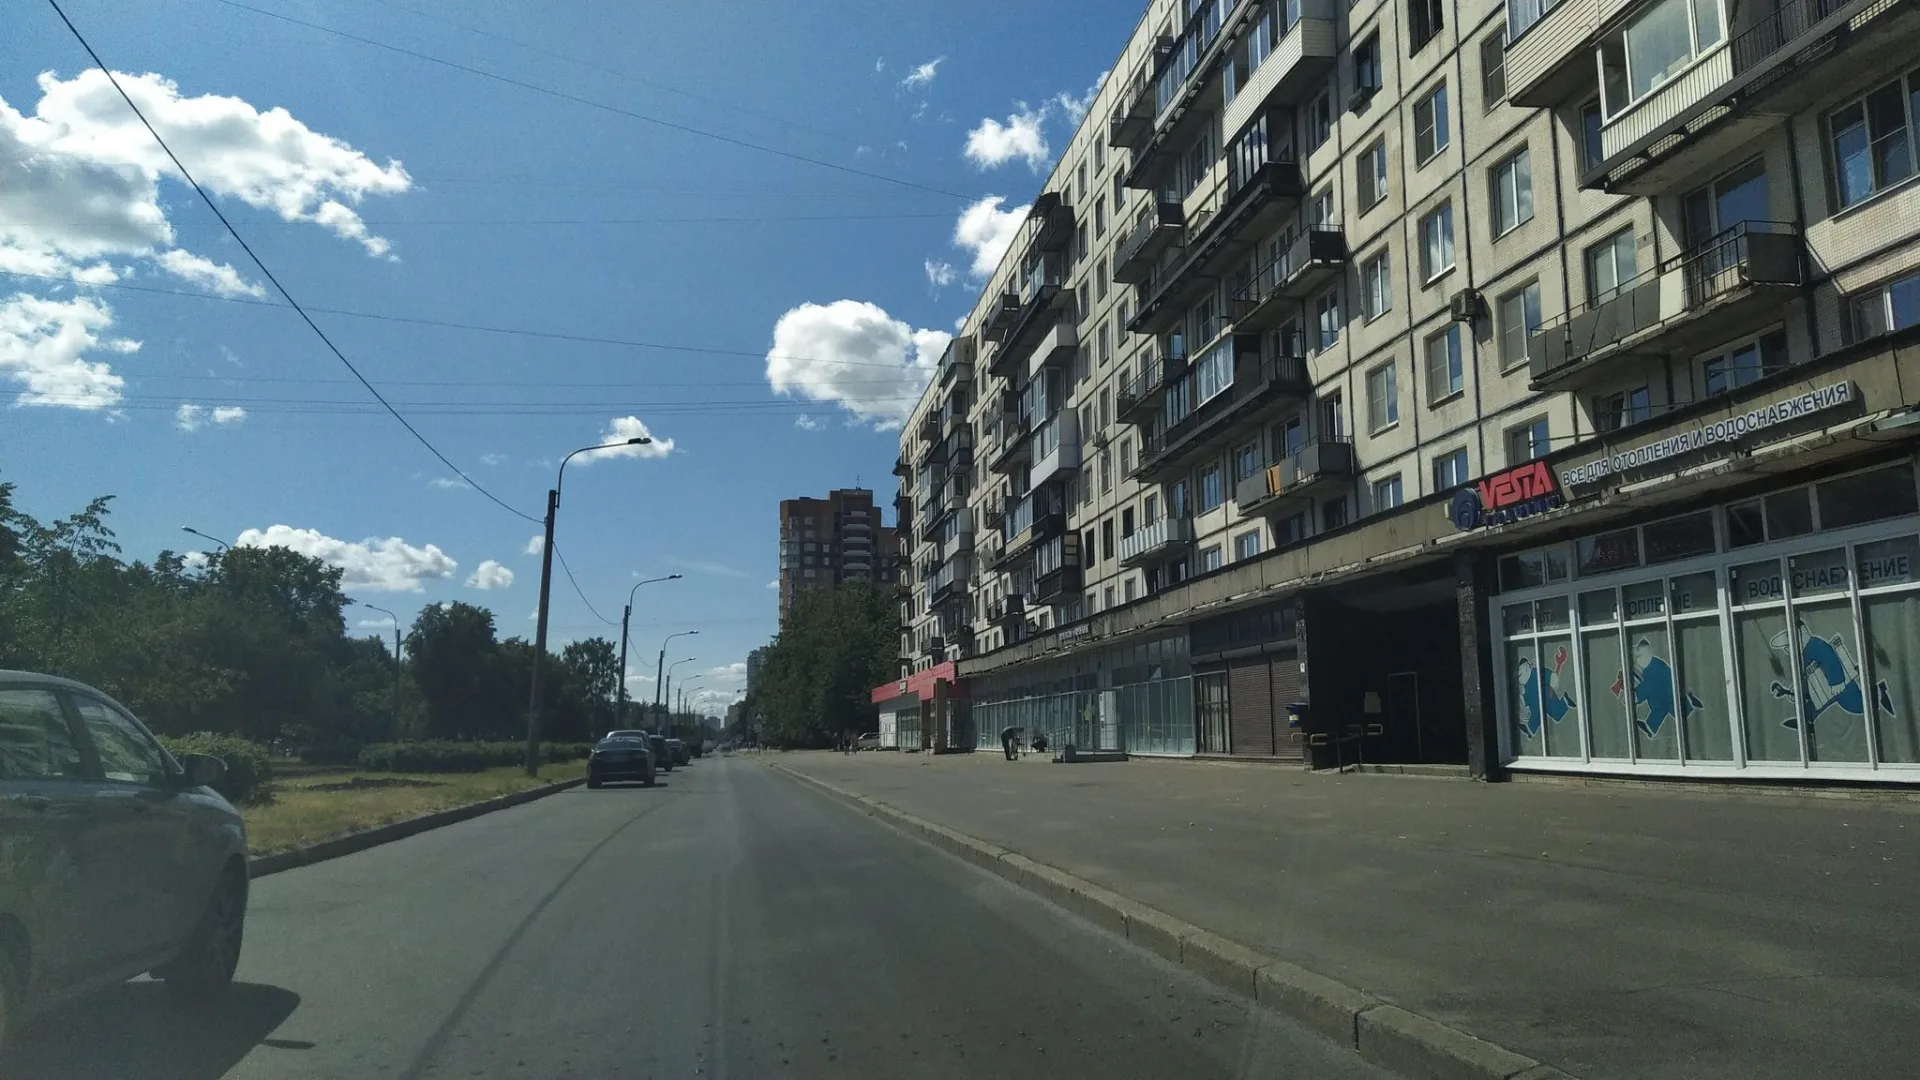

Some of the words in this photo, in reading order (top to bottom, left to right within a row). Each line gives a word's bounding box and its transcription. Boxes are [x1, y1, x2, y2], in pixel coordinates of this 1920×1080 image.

[1562, 467, 1584, 487] ВСЕ
[1586, 461, 1610, 483] ДЛЯ
[1613, 434, 1690, 472] ОТОПЛЕНИЯ
[1692, 430, 1704, 450] И
[1705, 381, 1849, 443] ВОДОСНАБЖЕНИЯ
[1478, 461, 1553, 510] VESTA
[1748, 556, 1909, 598] ВОДСНАБЕНИЕ
